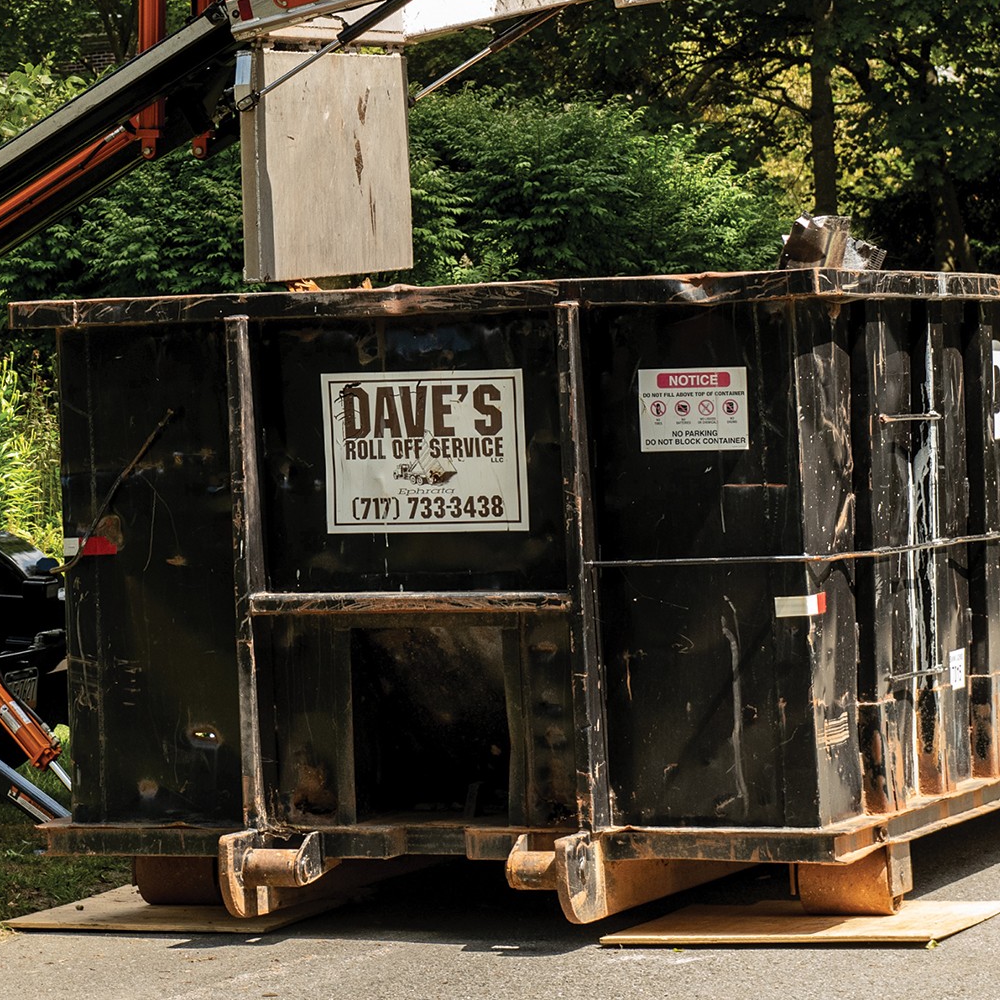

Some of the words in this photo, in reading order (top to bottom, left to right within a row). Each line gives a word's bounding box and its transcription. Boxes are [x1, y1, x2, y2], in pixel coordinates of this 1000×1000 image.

[669, 374, 718, 386] NOTICE
[344, 384, 503, 439] DAVE'S
[685, 429, 718, 437] PARKING
[346, 439, 386, 460] ROLL
[393, 438, 423, 459] OFF
[430, 437, 504, 459] SERVICE
[398, 488, 455, 496] Ephrata
[352, 496, 400, 520] (717)
[407, 495, 504, 519] 733-3438
